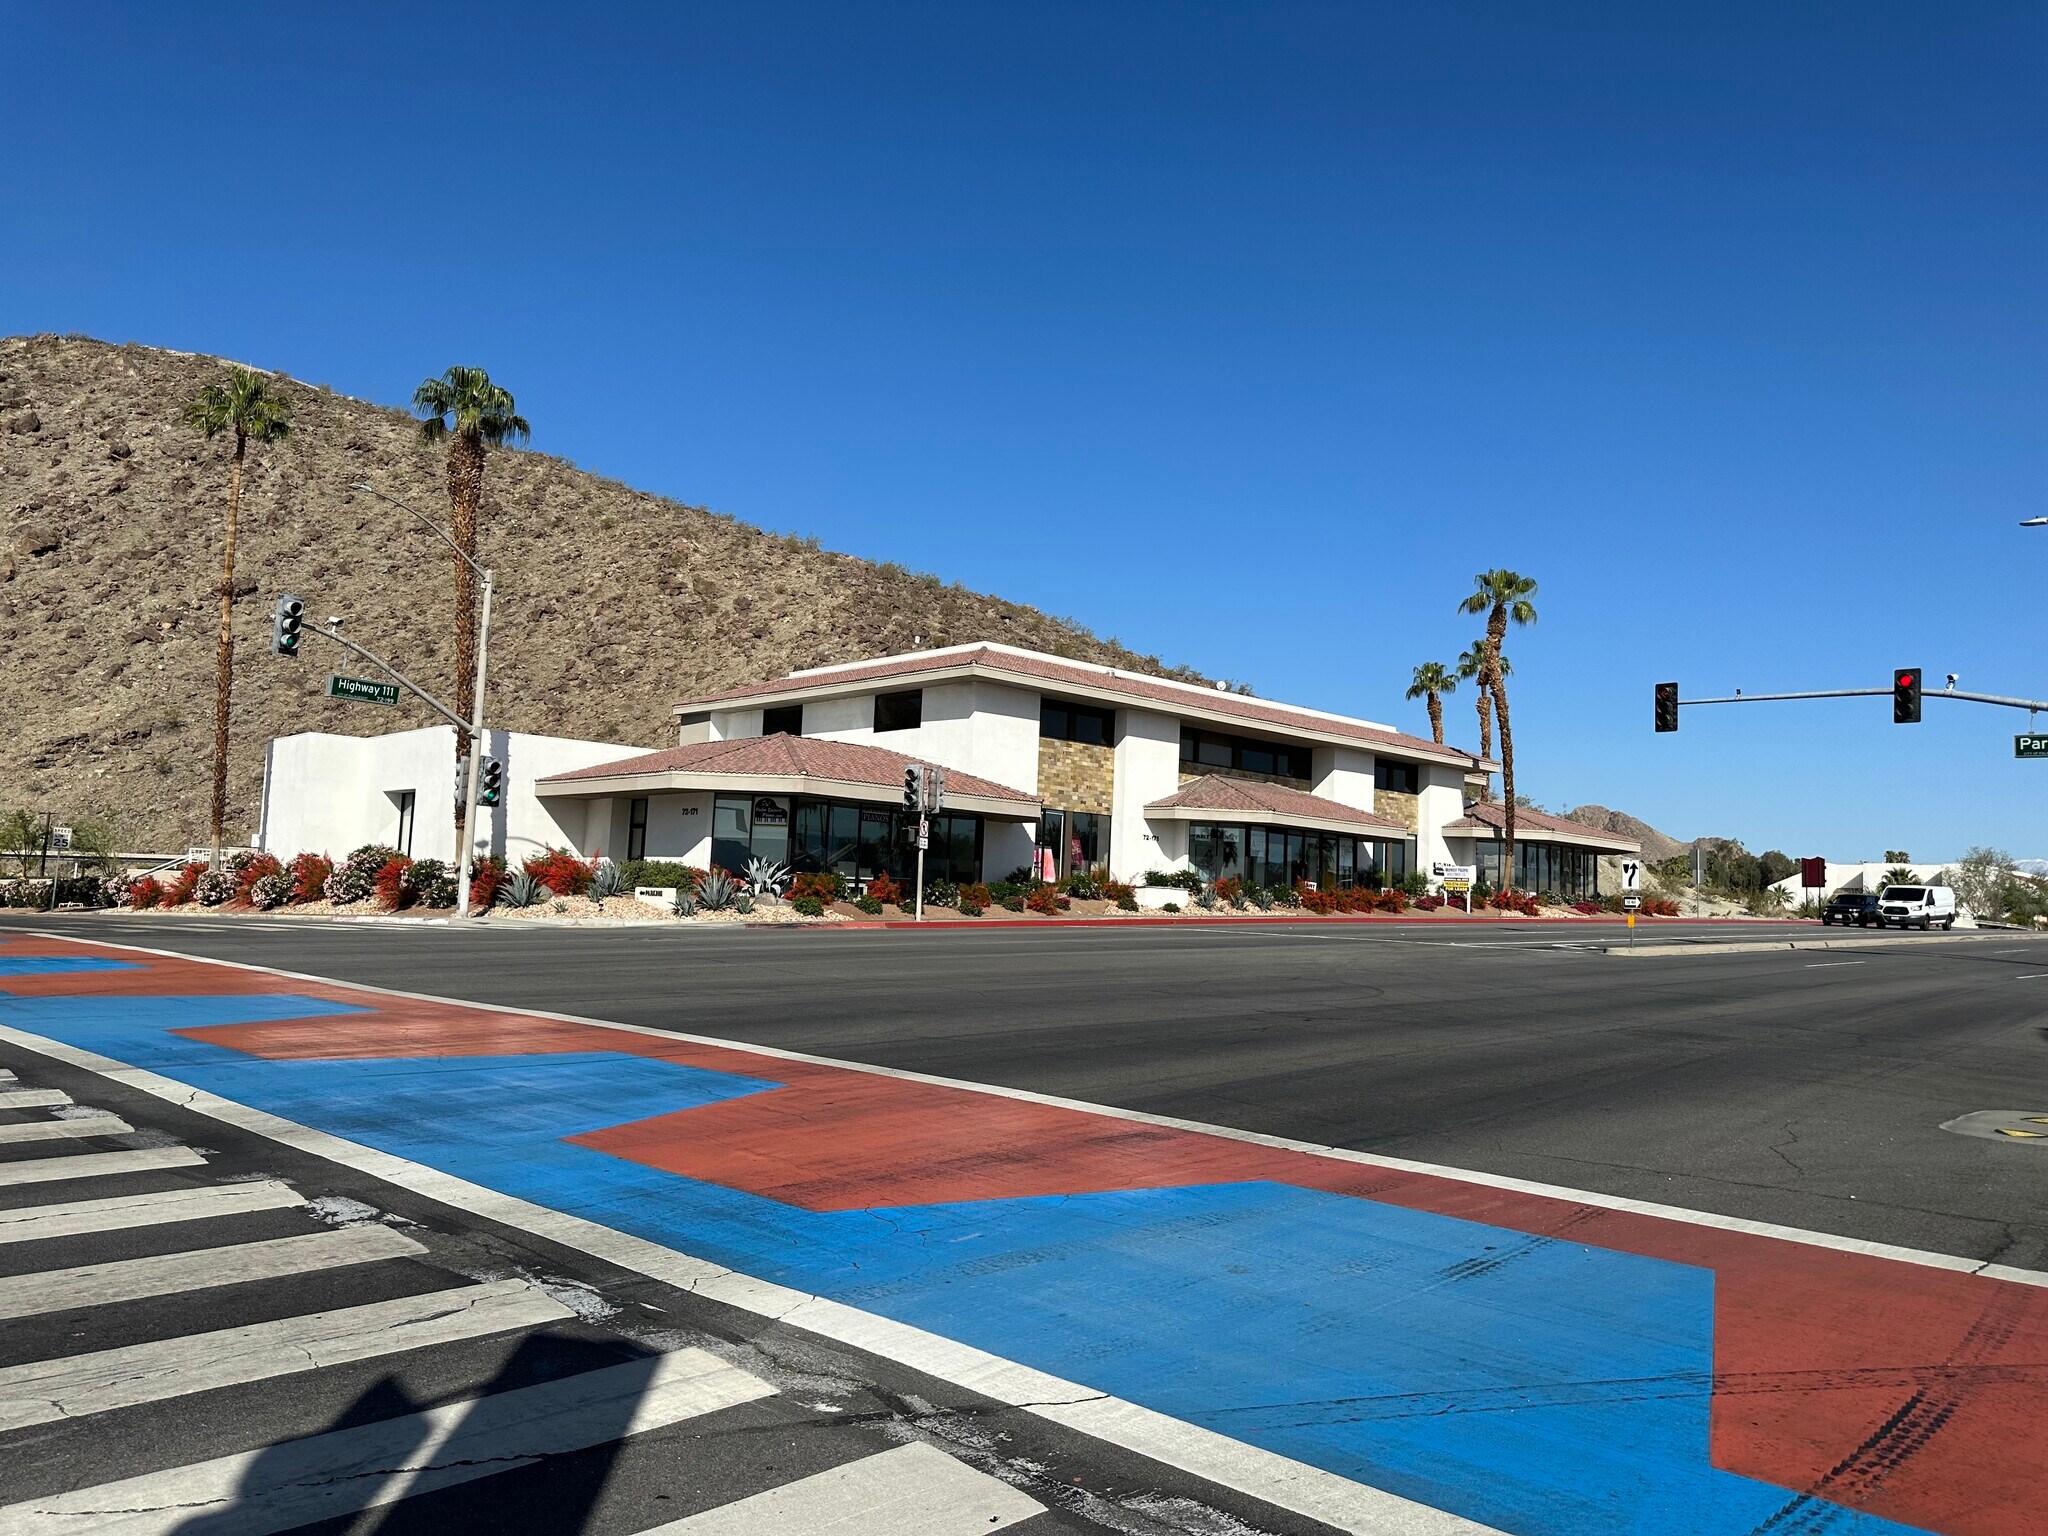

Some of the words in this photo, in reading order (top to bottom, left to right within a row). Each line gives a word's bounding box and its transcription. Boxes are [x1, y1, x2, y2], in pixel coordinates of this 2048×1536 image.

[338, 679, 380, 696] Highway
[382, 686, 394, 696] 111
[864, 814, 889, 822] PIANOS
[53, 838, 68, 847] 25
